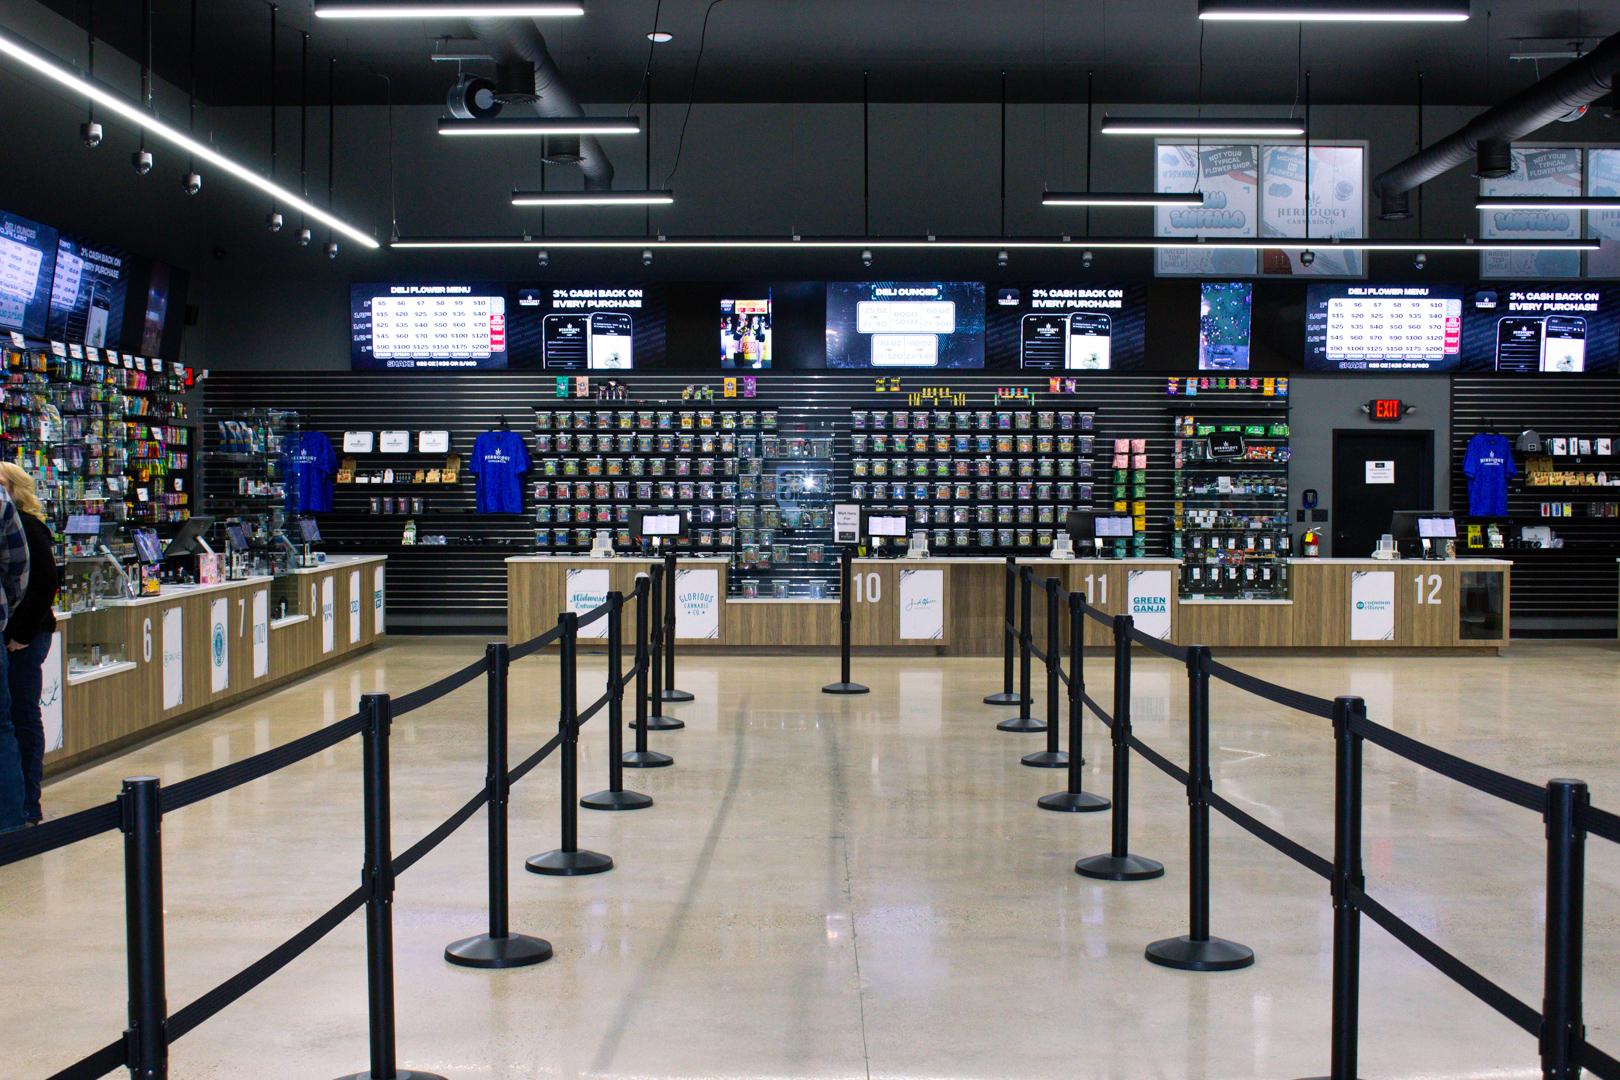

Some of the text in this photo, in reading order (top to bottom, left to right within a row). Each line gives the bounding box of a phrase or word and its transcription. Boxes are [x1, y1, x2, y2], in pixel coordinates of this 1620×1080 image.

[1208, 152, 1222, 162] NOT
[1214, 157, 1240, 166] TYPICAL
[1205, 164, 1232, 174] FLOWER
[89, 250, 101, 261] CASH
[102, 254, 114, 265] BACK
[114, 257, 122, 267] ON
[876, 288, 938, 296] DELI OUNCES
[1510, 292, 1599, 300] 3% CASH BACK ON
[1376, 400, 1398, 417] EXIT
[854, 572, 881, 603] 10
[1085, 574, 1107, 604] 11
[1414, 574, 1442, 605] 12
[311, 583, 317, 617] 8
[570, 593, 605, 603] Midwest
[679, 593, 714, 603] GLORIOUS
[238, 598, 245, 637] 7
[144, 618, 152, 663] 6
